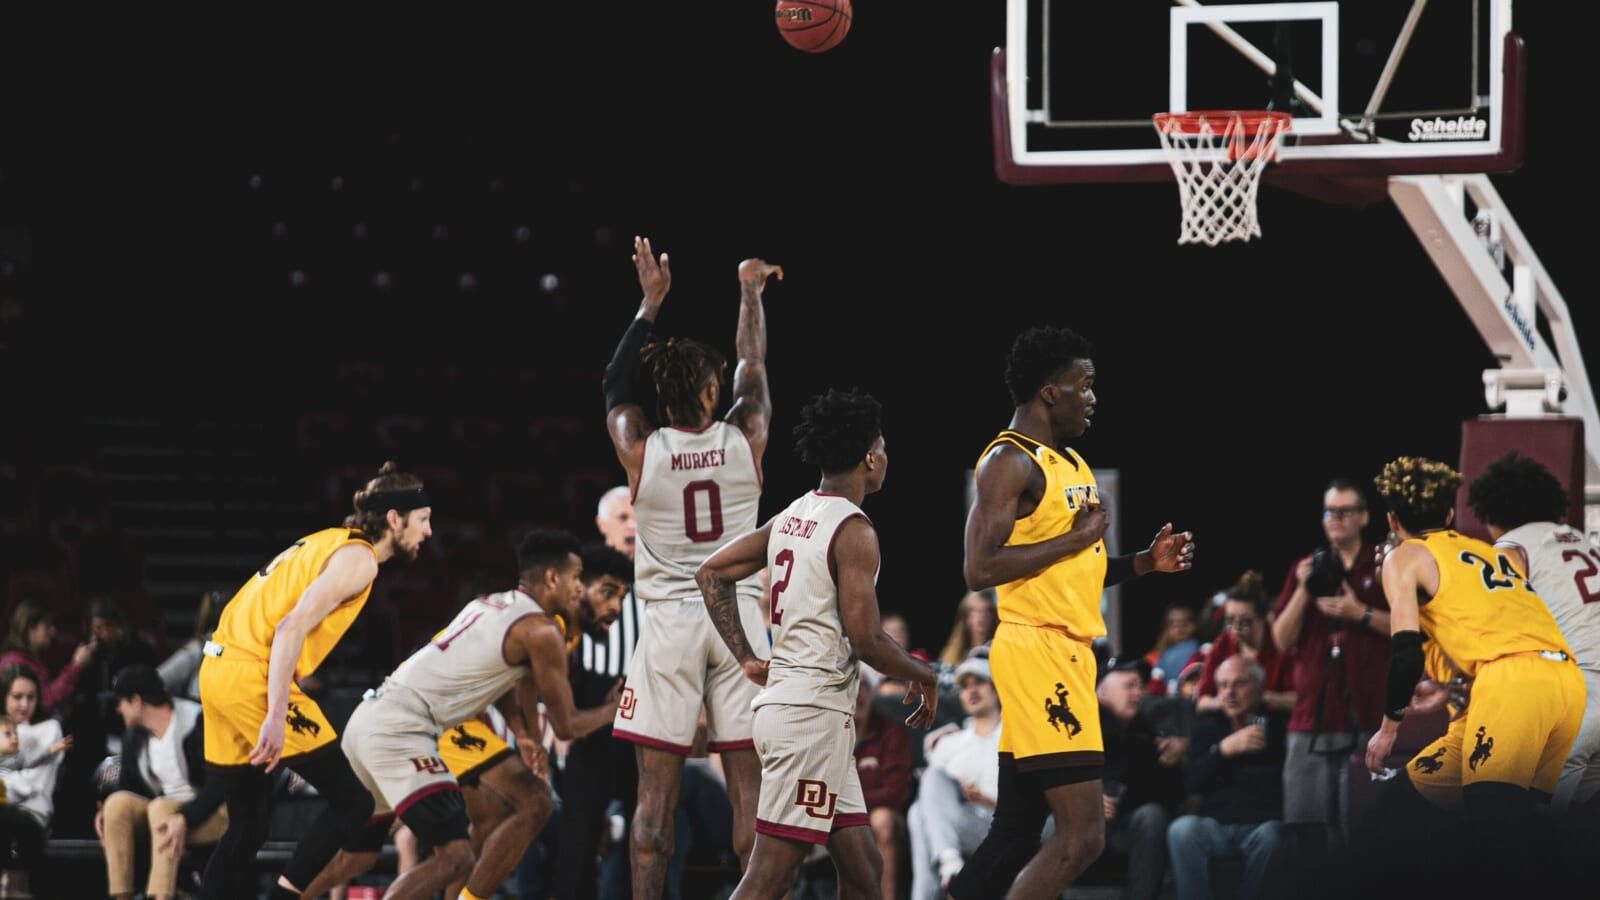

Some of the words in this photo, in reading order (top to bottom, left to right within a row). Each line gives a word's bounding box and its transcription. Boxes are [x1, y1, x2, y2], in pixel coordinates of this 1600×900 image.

[1408, 116, 1486, 140] Schelde
[671, 448, 726, 471] MURKEY
[683, 479, 724, 543] 0
[771, 548, 795, 626] 2
[1460, 551, 1536, 592] 24
[794, 779, 838, 820] DU
